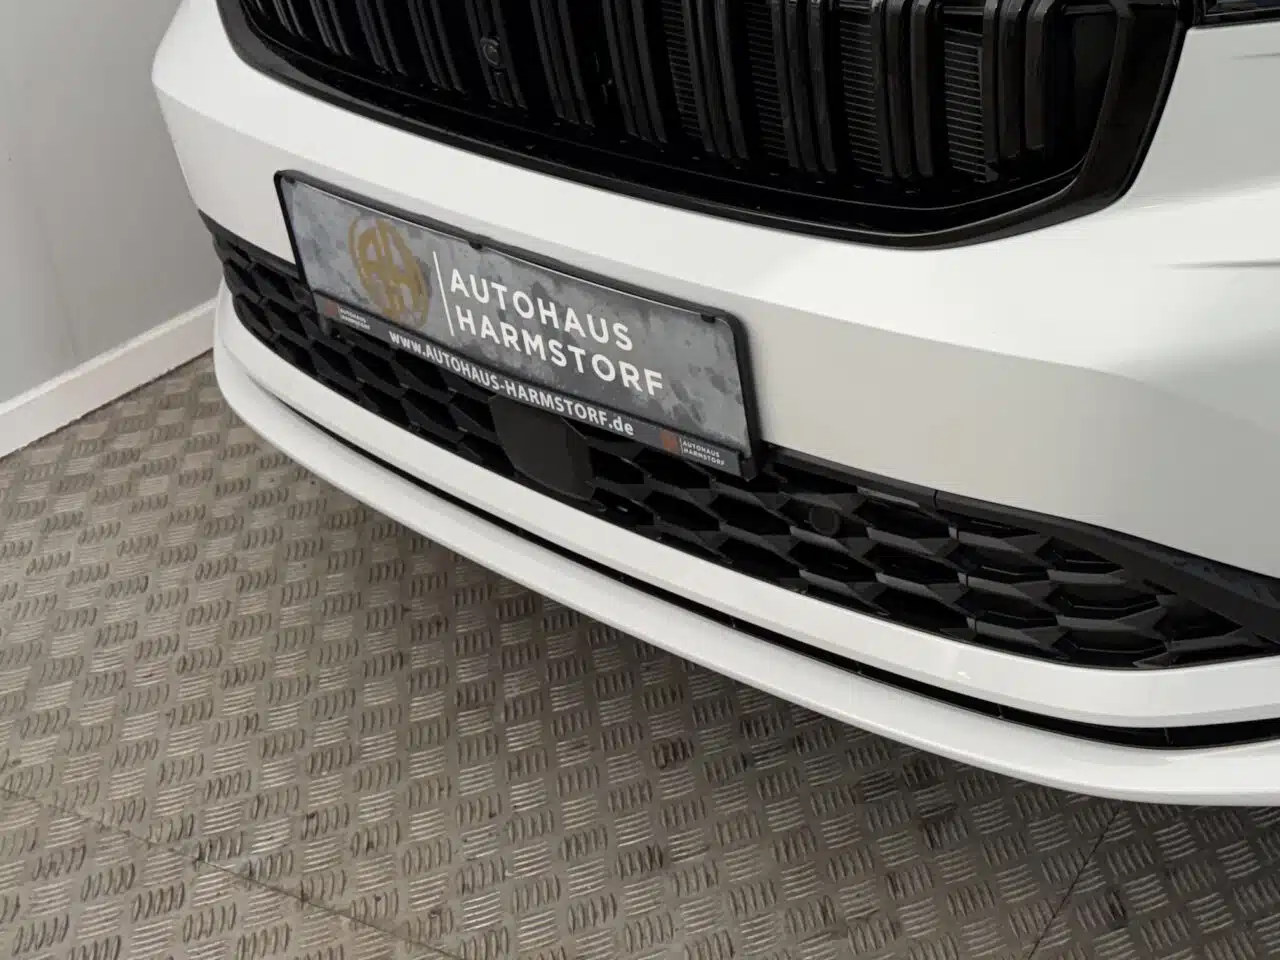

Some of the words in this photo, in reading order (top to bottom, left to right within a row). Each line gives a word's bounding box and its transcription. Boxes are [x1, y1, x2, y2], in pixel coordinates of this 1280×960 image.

[451, 268, 633, 351] AUTOHAUS
[456, 305, 664, 396] HARMSTORF
[388, 330, 635, 436] www.AUTOHAUS-HARMSTORF.de
[682, 440, 721, 458] AUTOHAUS
